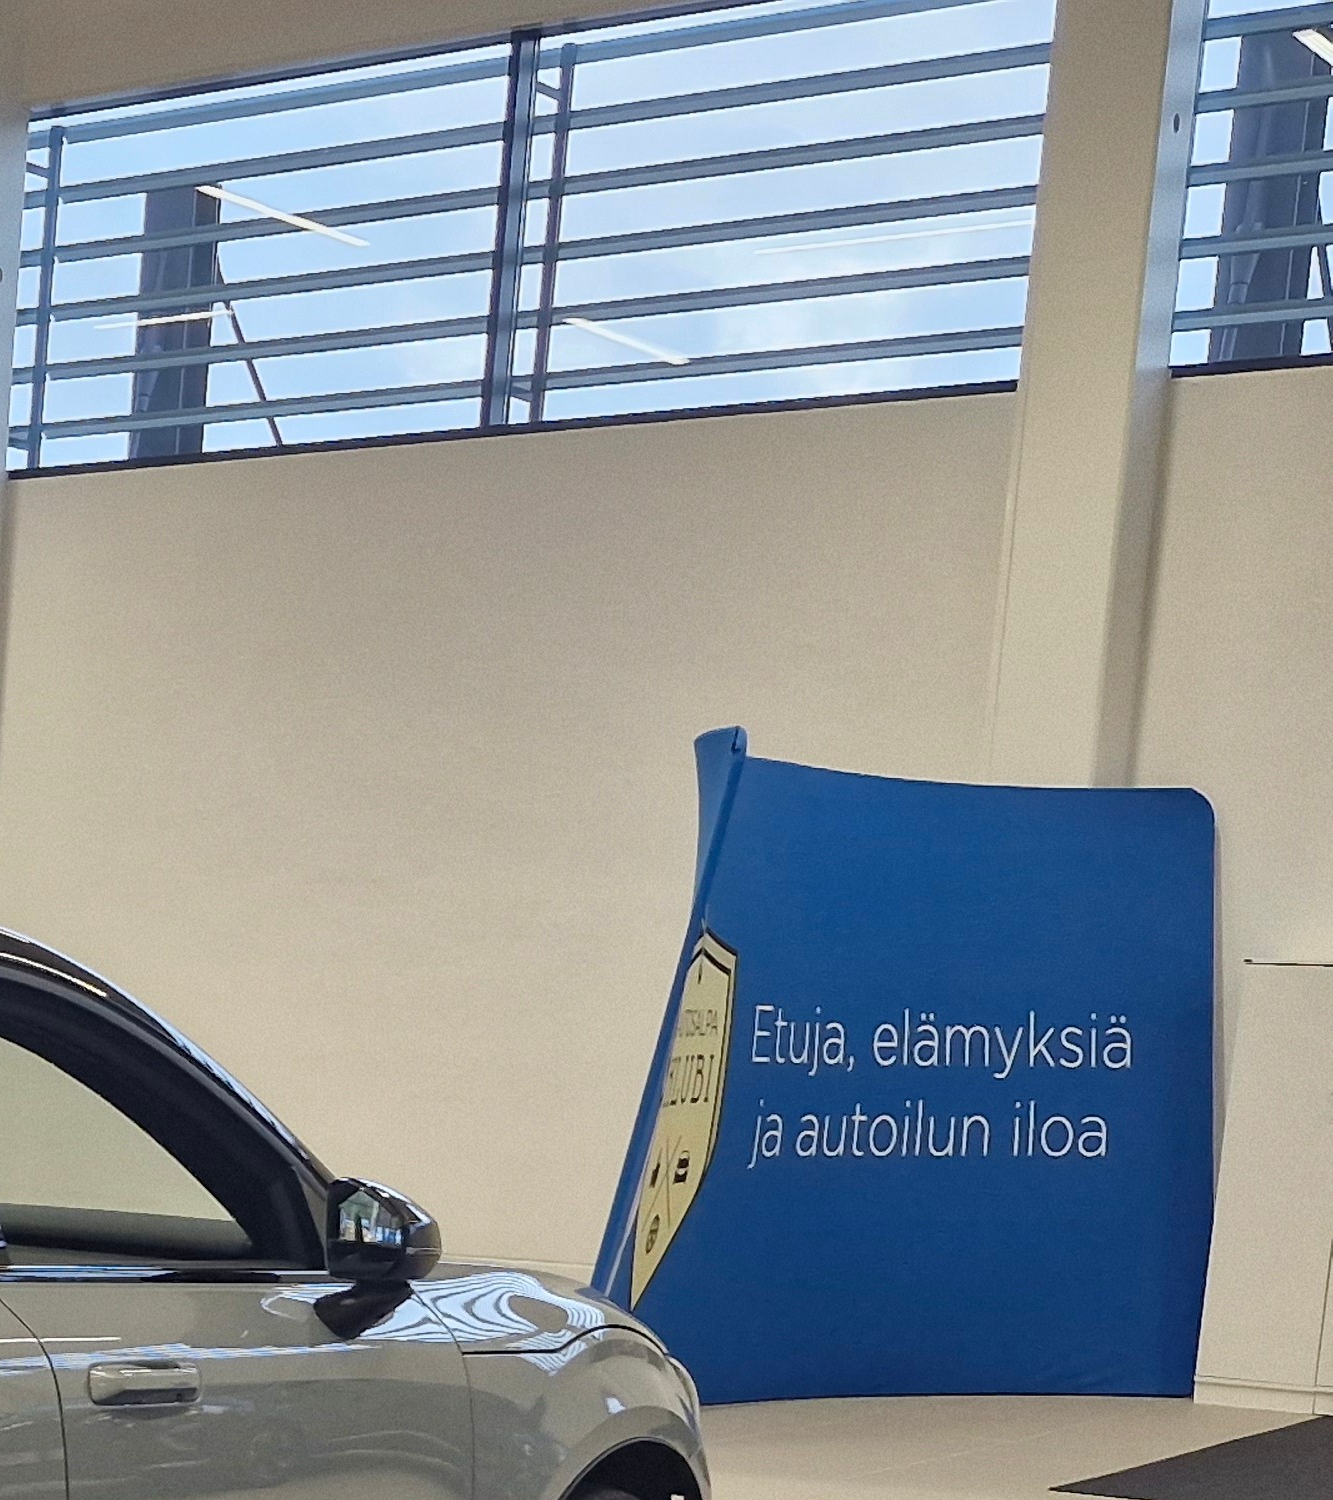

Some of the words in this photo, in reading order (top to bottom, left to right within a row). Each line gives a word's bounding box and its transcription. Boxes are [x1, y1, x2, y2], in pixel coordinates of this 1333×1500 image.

[751, 1004, 855, 1077] Etuja,
[873, 1008, 1132, 1079] elämyksiä
[747, 1099, 784, 1169] ja
[795, 1099, 991, 1158] autoilun
[1011, 1100, 1108, 1158] iloa
